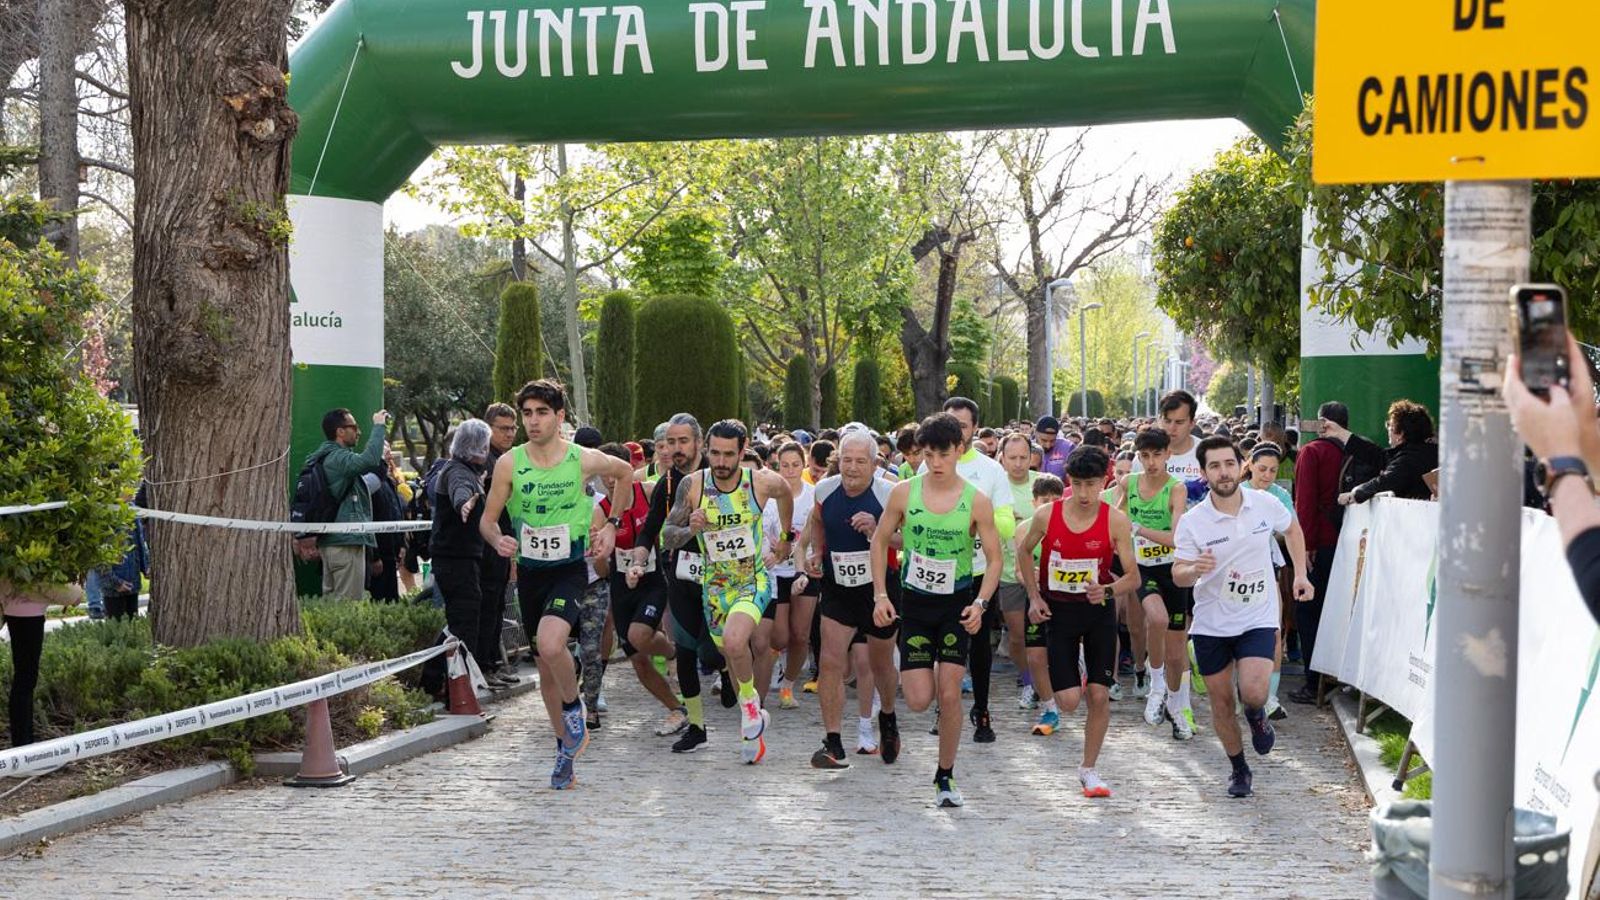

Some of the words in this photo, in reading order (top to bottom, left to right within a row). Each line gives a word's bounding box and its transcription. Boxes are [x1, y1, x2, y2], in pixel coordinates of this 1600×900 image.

[1453, 0, 1505, 31] DE
[450, 5, 654, 79] JUNTA
[688, 0, 769, 72] DE
[1357, 66, 1589, 137] CAMIONES
[537, 481, 574, 490] Fundación
[537, 488, 565, 496] Unicaja
[717, 514, 741, 526] 1153
[530, 536, 560, 550] 515
[715, 537, 746, 552] 542
[1143, 545, 1170, 558] 550
[838, 564, 866, 577] 505
[916, 567, 946, 584] 352
[1056, 570, 1089, 583] 727
[1228, 580, 1265, 595] 1015
[84, 736, 109, 750] DEPORTES
